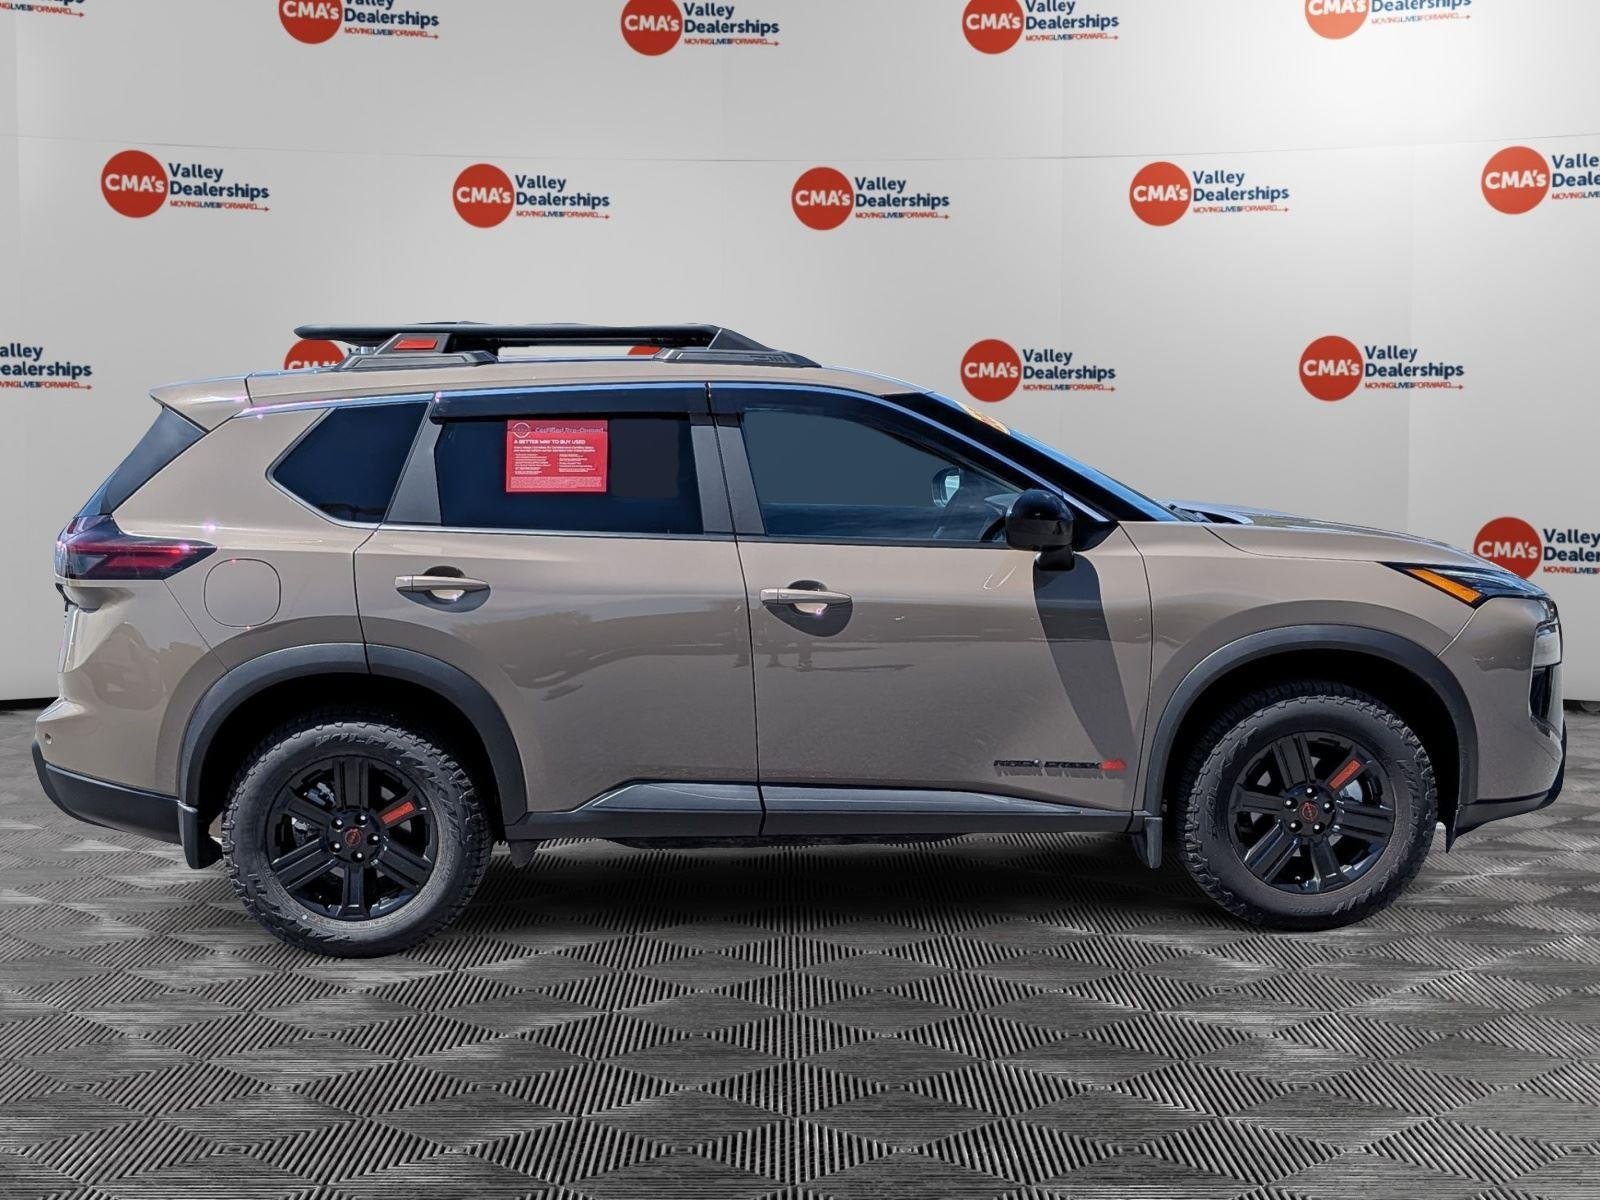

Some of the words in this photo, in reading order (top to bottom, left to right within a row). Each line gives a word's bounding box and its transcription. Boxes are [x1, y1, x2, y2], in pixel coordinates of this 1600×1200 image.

[282, 1, 340, 20] CMA's
[683, 2, 735, 19] Valley
[1025, 0, 1076, 15] Valley
[1371, 0, 1472, 13] Dealerships
[344, 8, 439, 28] Dealerships
[624, 14, 680, 32] CMA's
[966, 13, 1021, 30] CMA's
[1025, 14, 1120, 30] Dealerships
[684, 19, 780, 36] Dealerships
[1552, 153, 1600, 170] Valle
[168, 163, 223, 182] Valley
[1193, 170, 1245, 186] Valley
[1485, 169, 1547, 189] CMA's
[1552, 171, 1600, 187] Deale
[105, 174, 165, 193] CMA's
[169, 181, 270, 201] Dealerships
[515, 175, 567, 192] Valley
[855, 177, 906, 193] Valley
[456, 186, 511, 204] CMA's
[516, 192, 610, 209] Dealerships
[795, 190, 850, 206] CMA's
[1133, 184, 1188, 202] CMA's
[1193, 186, 1290, 202] Dealerships
[855, 194, 950, 210] Dealerships
[1023, 349, 1072, 365] Valley
[1365, 345, 1418, 362] Valley
[964, 362, 1018, 378] CMA's
[1023, 365, 1116, 382] Dealerships
[1303, 359, 1360, 376] CMA's
[1365, 362, 1464, 379] Dealerships
[1543, 528, 1600, 548] Valley
[1478, 540, 1538, 559] CMA's
